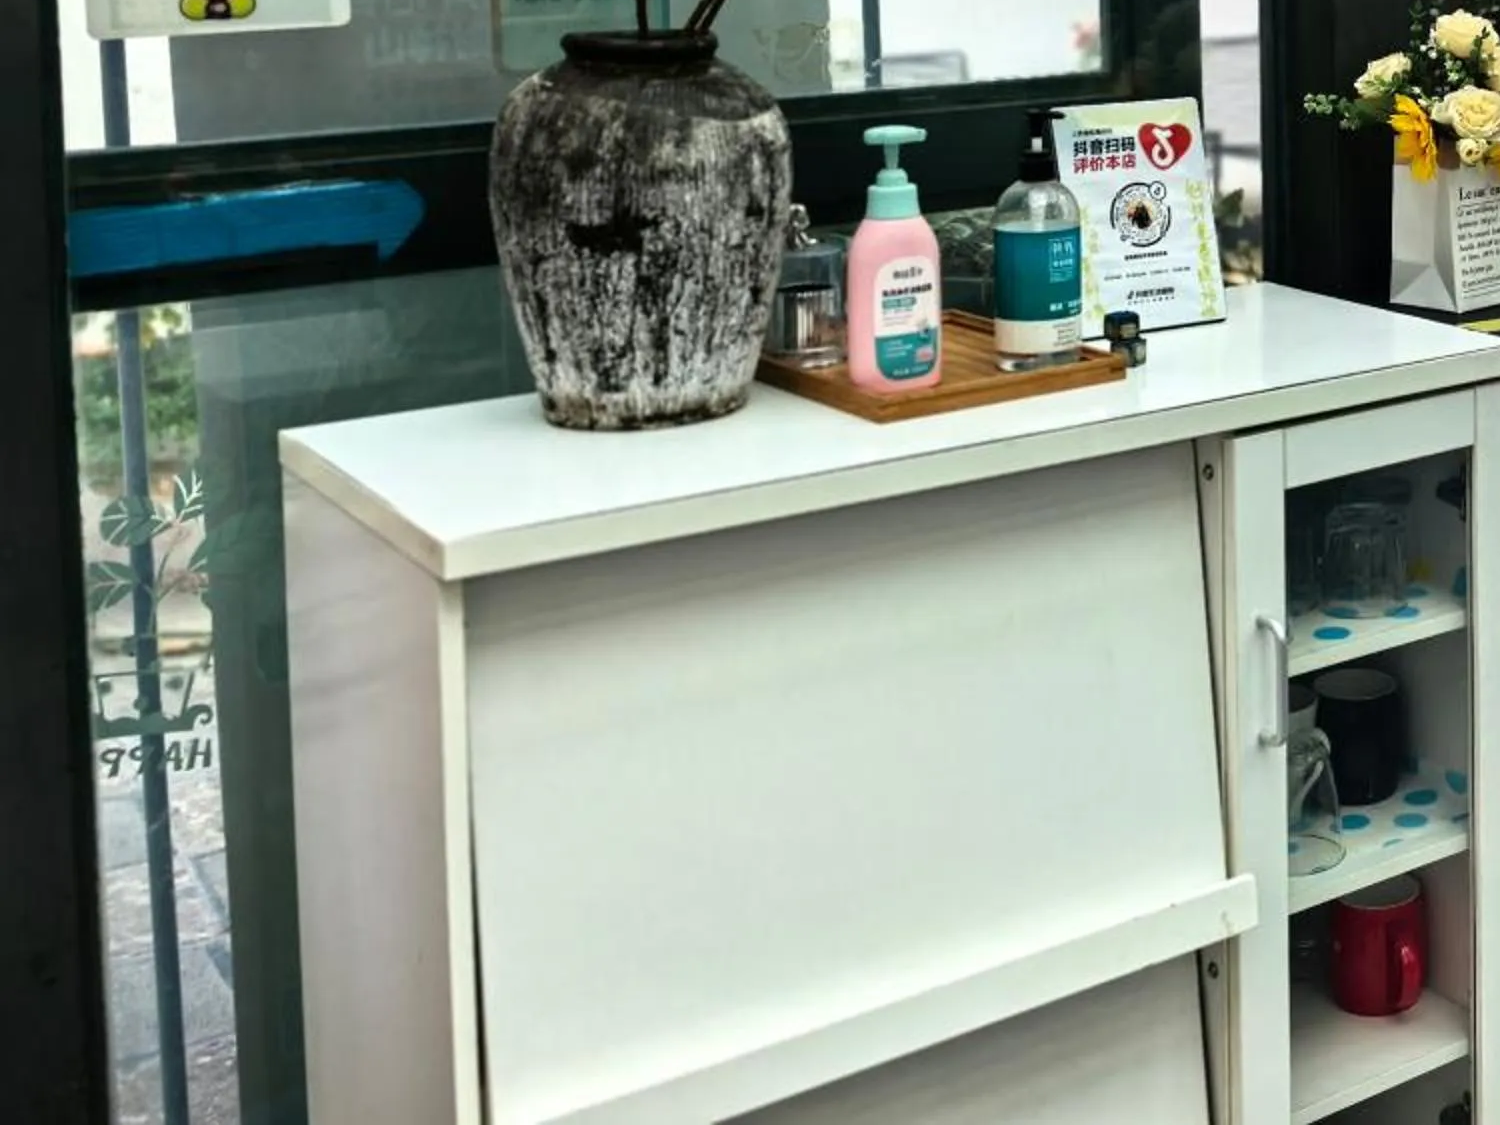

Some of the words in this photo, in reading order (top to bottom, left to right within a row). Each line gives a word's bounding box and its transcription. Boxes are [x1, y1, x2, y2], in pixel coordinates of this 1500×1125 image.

[1073, 136, 1136, 157] 抖音扫码
[1073, 154, 1137, 174] 评价本店
